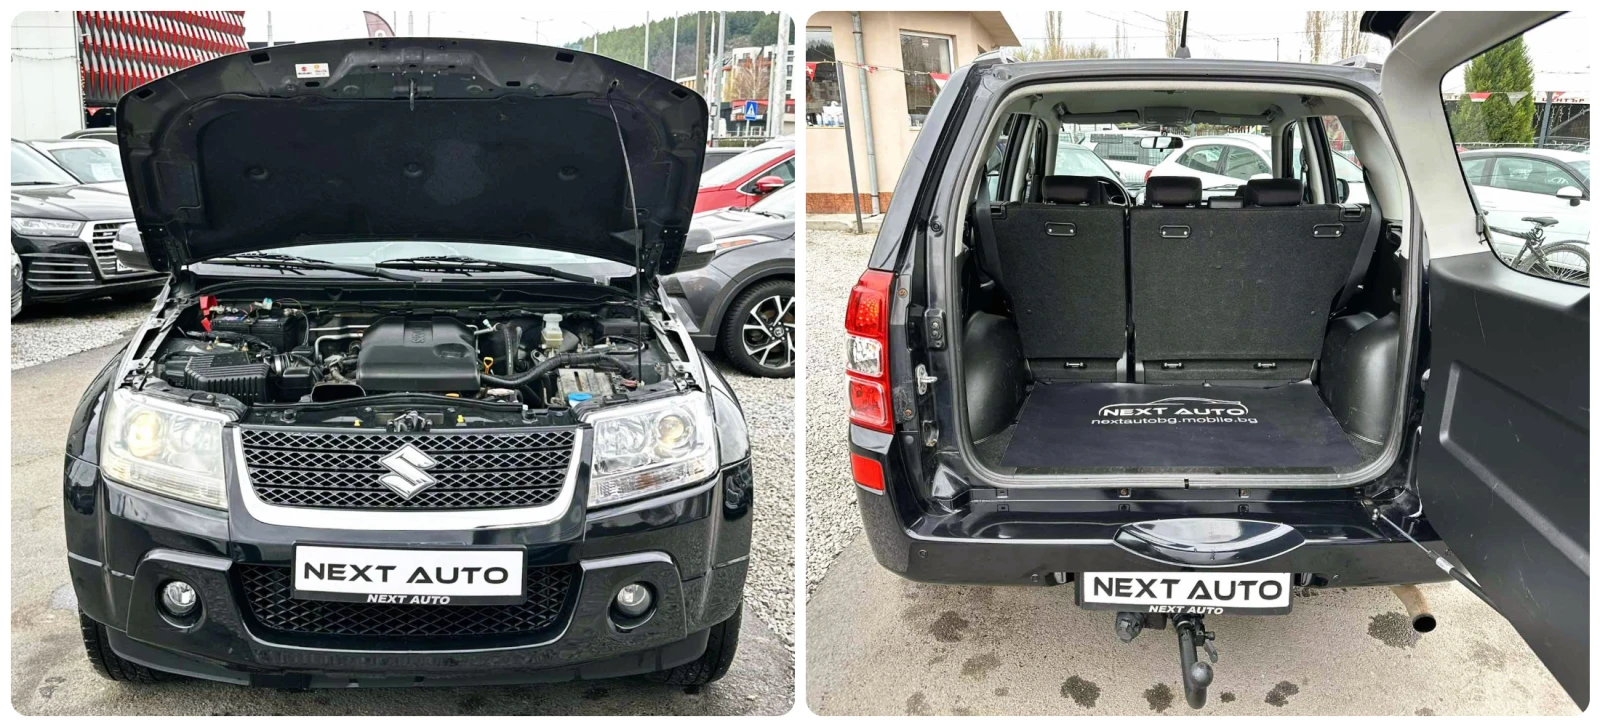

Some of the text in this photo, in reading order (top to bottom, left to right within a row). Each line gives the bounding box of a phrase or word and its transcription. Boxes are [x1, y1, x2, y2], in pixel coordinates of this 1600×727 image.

[1103, 407, 1245, 416] NEXT AUTO
[1091, 416, 1258, 425] nextautobg.mobile.bg
[304, 562, 509, 584] NEXT AUTO
[1094, 577, 1282, 600] NEXT AUTO
[367, 594, 450, 605] NEXT AUTO
[1149, 605, 1224, 615] NEXT AUTO
